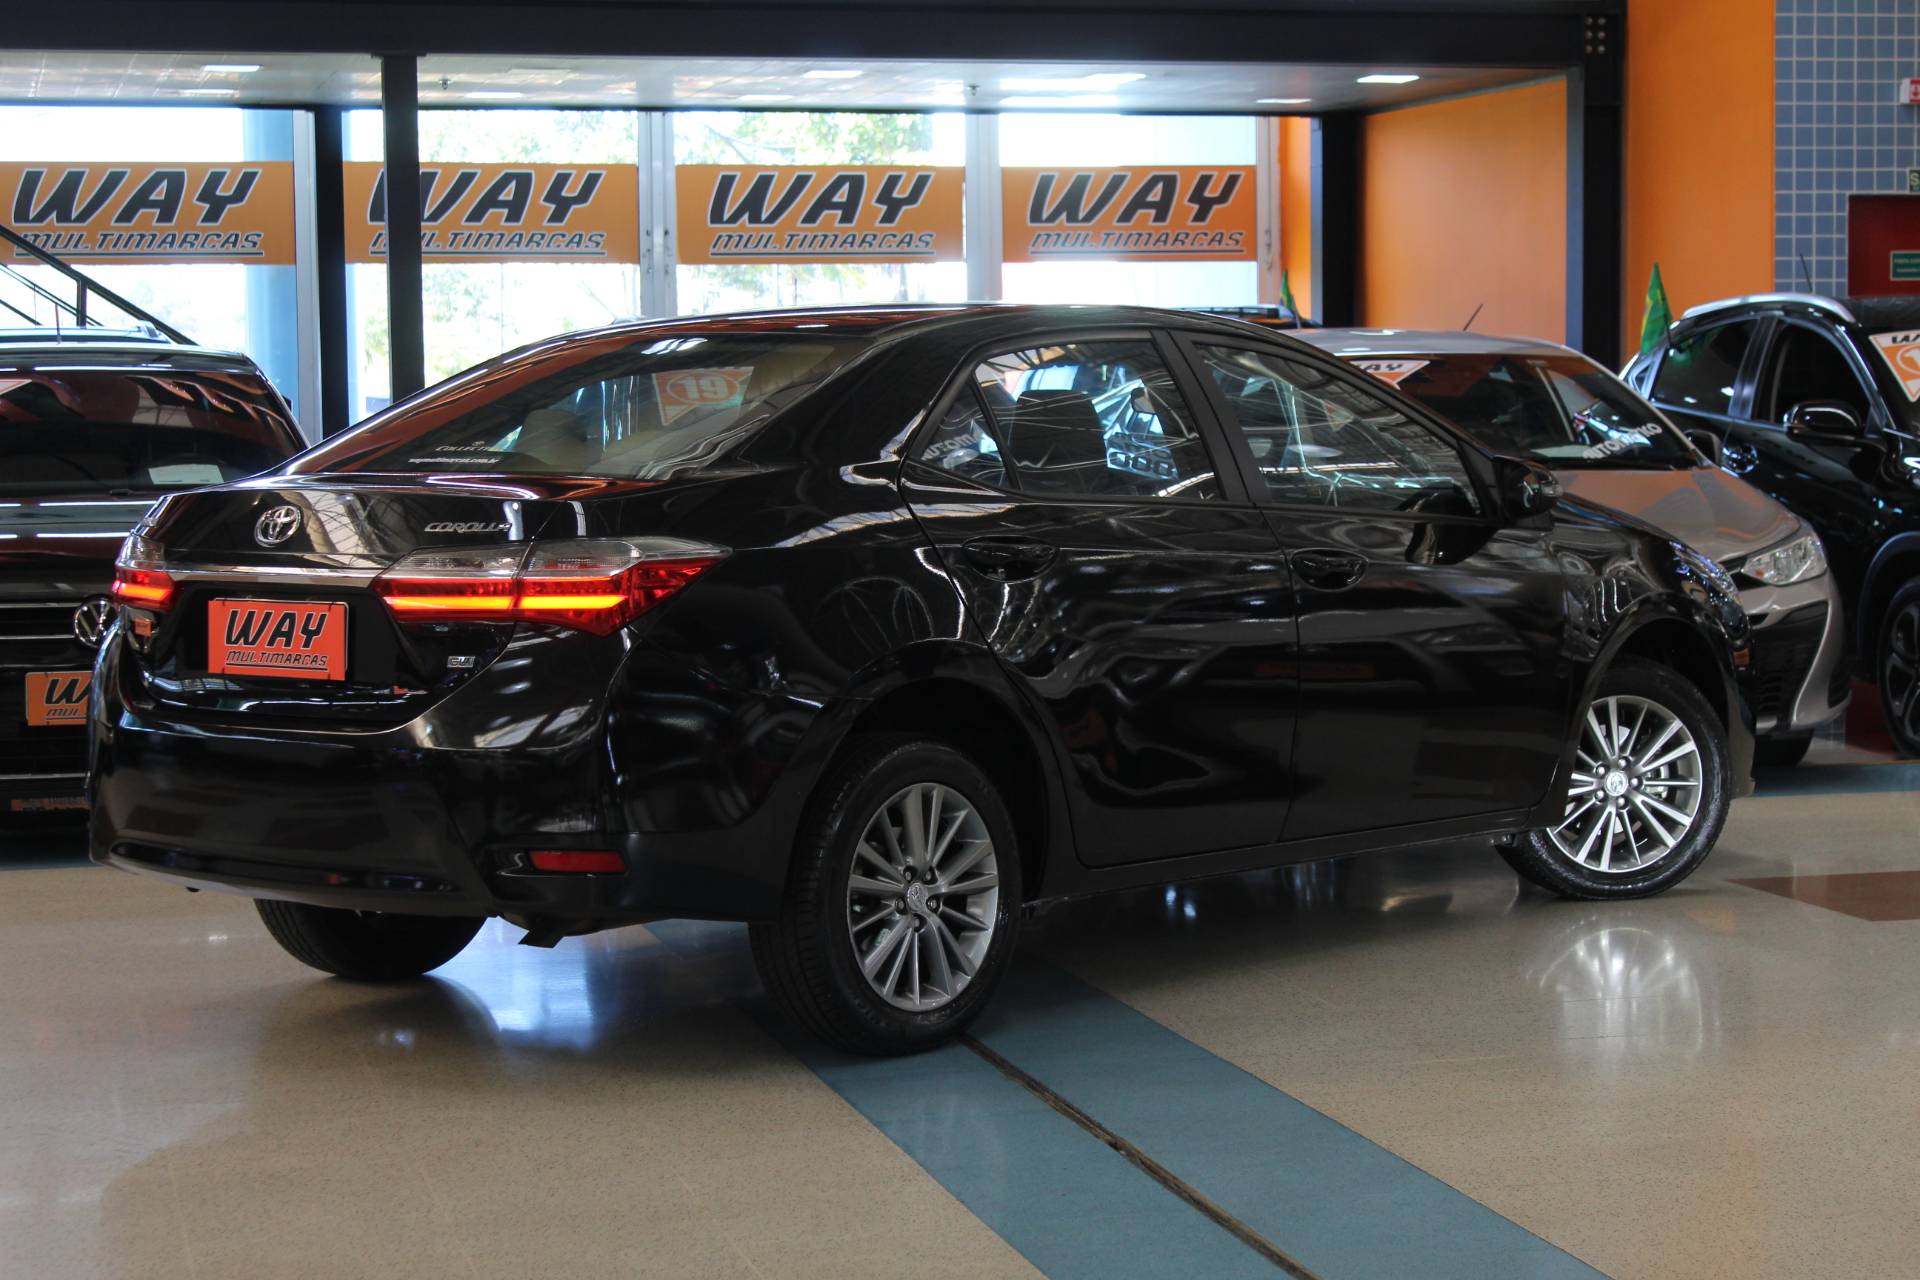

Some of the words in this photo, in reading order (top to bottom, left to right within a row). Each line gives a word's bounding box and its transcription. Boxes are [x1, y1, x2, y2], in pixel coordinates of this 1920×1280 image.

[12, 168, 262, 226] WAY
[368, 168, 606, 226] WAY
[708, 171, 935, 227] WAY
[1027, 171, 1246, 226] WAY
[710, 231, 935, 250] MULTIMARCAS
[1029, 230, 1245, 248] MULTIMARCAS
[674, 375, 729, 400] 19
[424, 521, 512, 533] COROLLA
[224, 608, 328, 650] WAY
[225, 650, 328, 667] MULTIMARCAS
